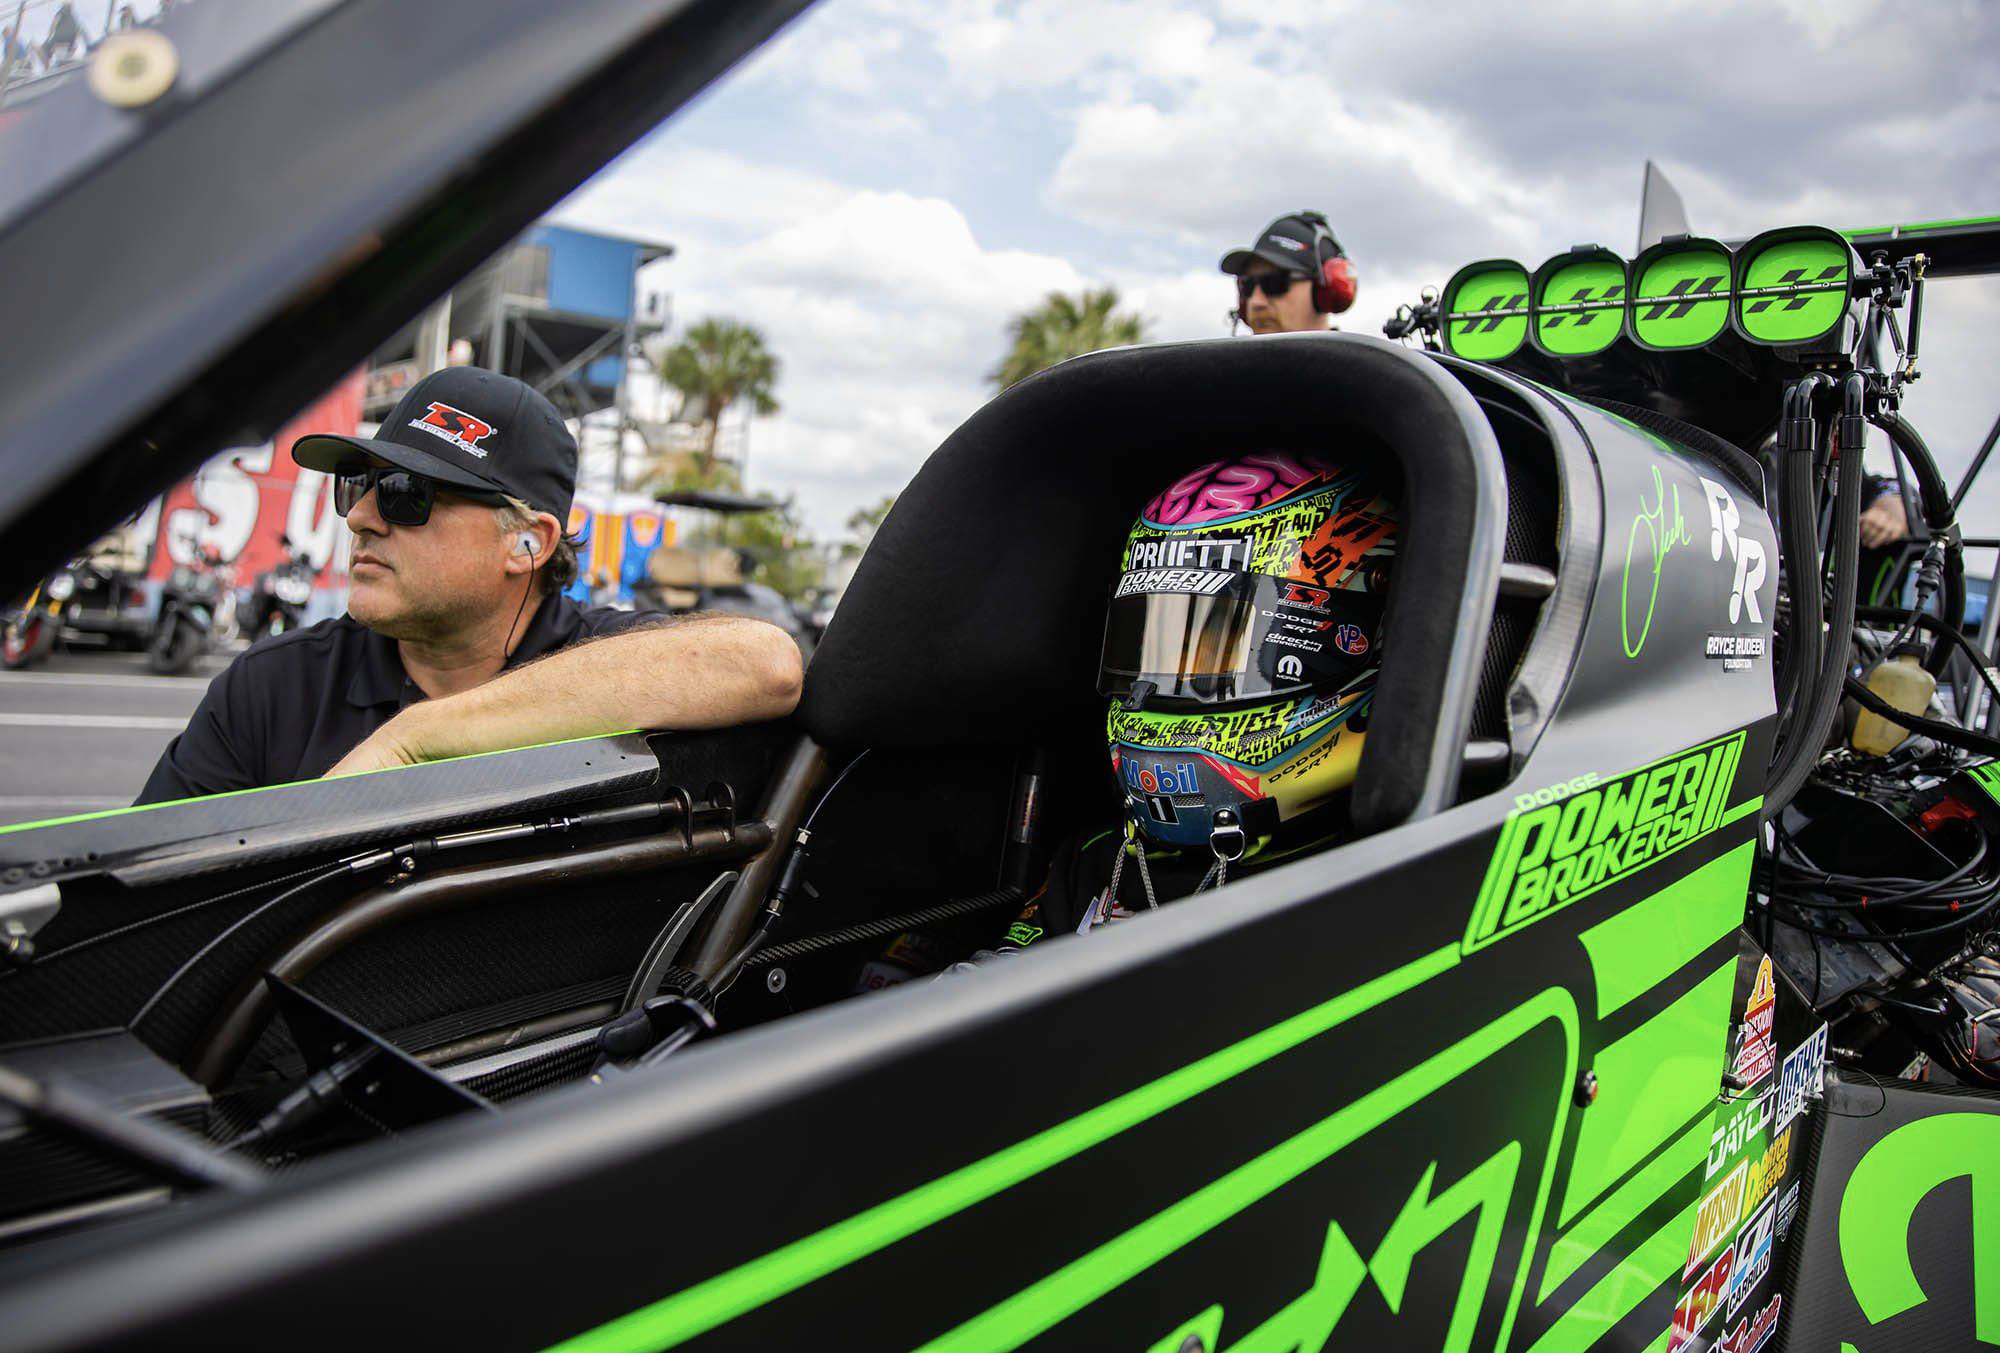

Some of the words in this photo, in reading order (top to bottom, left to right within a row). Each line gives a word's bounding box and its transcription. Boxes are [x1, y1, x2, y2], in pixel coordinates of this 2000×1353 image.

[1122, 581, 1196, 594] BROKERS
[1261, 610, 1323, 628] DODGE
[1282, 623, 1318, 634] SRT
[1337, 624, 1361, 652] VP
[1706, 636, 1735, 655] RAYCE
[1735, 637, 1766, 655] RUDEEN
[1122, 757, 1199, 794] Mobil
[1267, 742, 1337, 784] DODGE
[1294, 752, 1330, 779] SRT
[1512, 771, 1600, 812] DODGE
[1149, 797, 1168, 823] 1
[1502, 803, 1700, 927] BROKERS
[1781, 1030, 1824, 1108] MAHLE
[1706, 1087, 1775, 1182] DAYCO
[1728, 1250, 1770, 1317] CARRILLO
